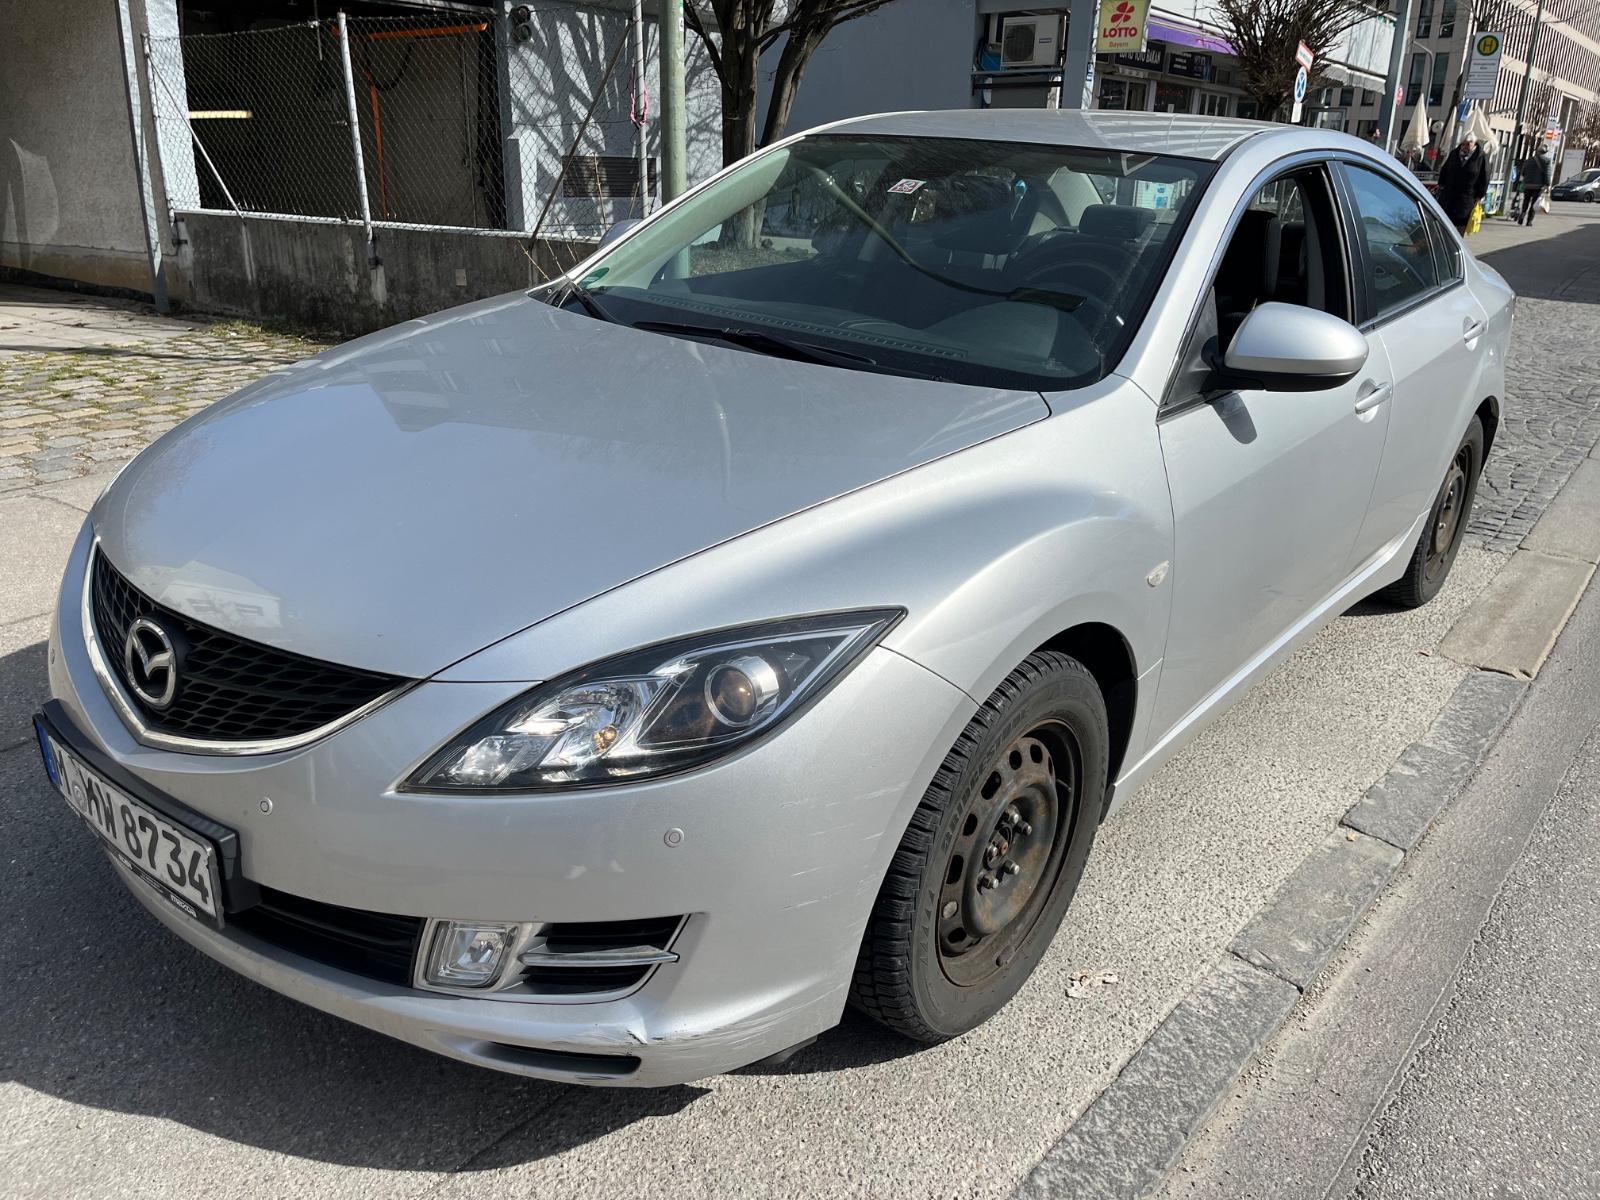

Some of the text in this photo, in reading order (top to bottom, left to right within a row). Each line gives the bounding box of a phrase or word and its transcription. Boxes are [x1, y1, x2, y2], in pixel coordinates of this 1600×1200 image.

[1103, 27, 1137, 38] LOTTO
[1482, 39, 1494, 52] H
[51, 742, 71, 795] M
[120, 804, 209, 904] 8734
